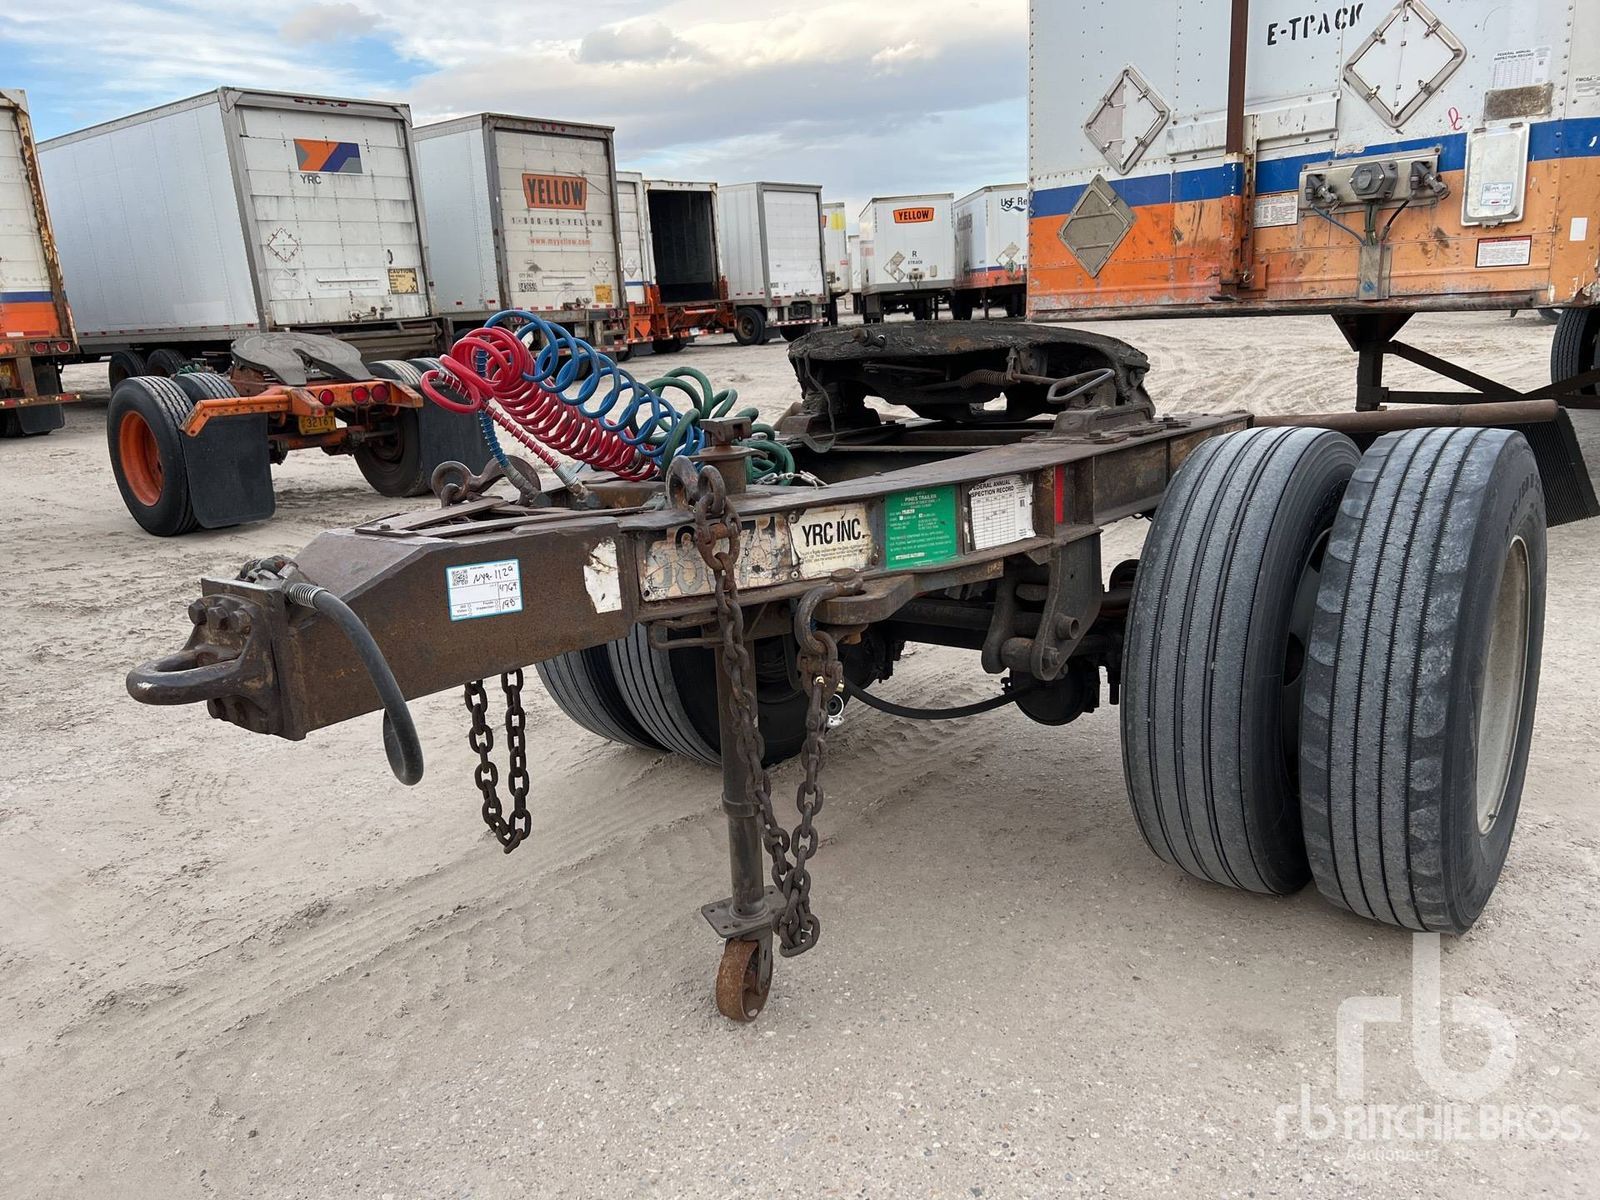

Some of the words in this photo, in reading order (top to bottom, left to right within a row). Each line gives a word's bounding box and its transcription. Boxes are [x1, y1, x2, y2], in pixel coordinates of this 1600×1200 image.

[300, 174, 322, 185] YRC
[527, 178, 583, 205] YELLOW
[898, 210, 930, 221] YELLOW
[529, 237, 592, 247] www.myyellow.com
[993, 479, 1011, 487] ANNUAL
[970, 488, 996, 498] SPECTION
[996, 485, 1014, 494] RECORD
[802, 522, 833, 547] YRC
[837, 518, 866, 542] INC.
